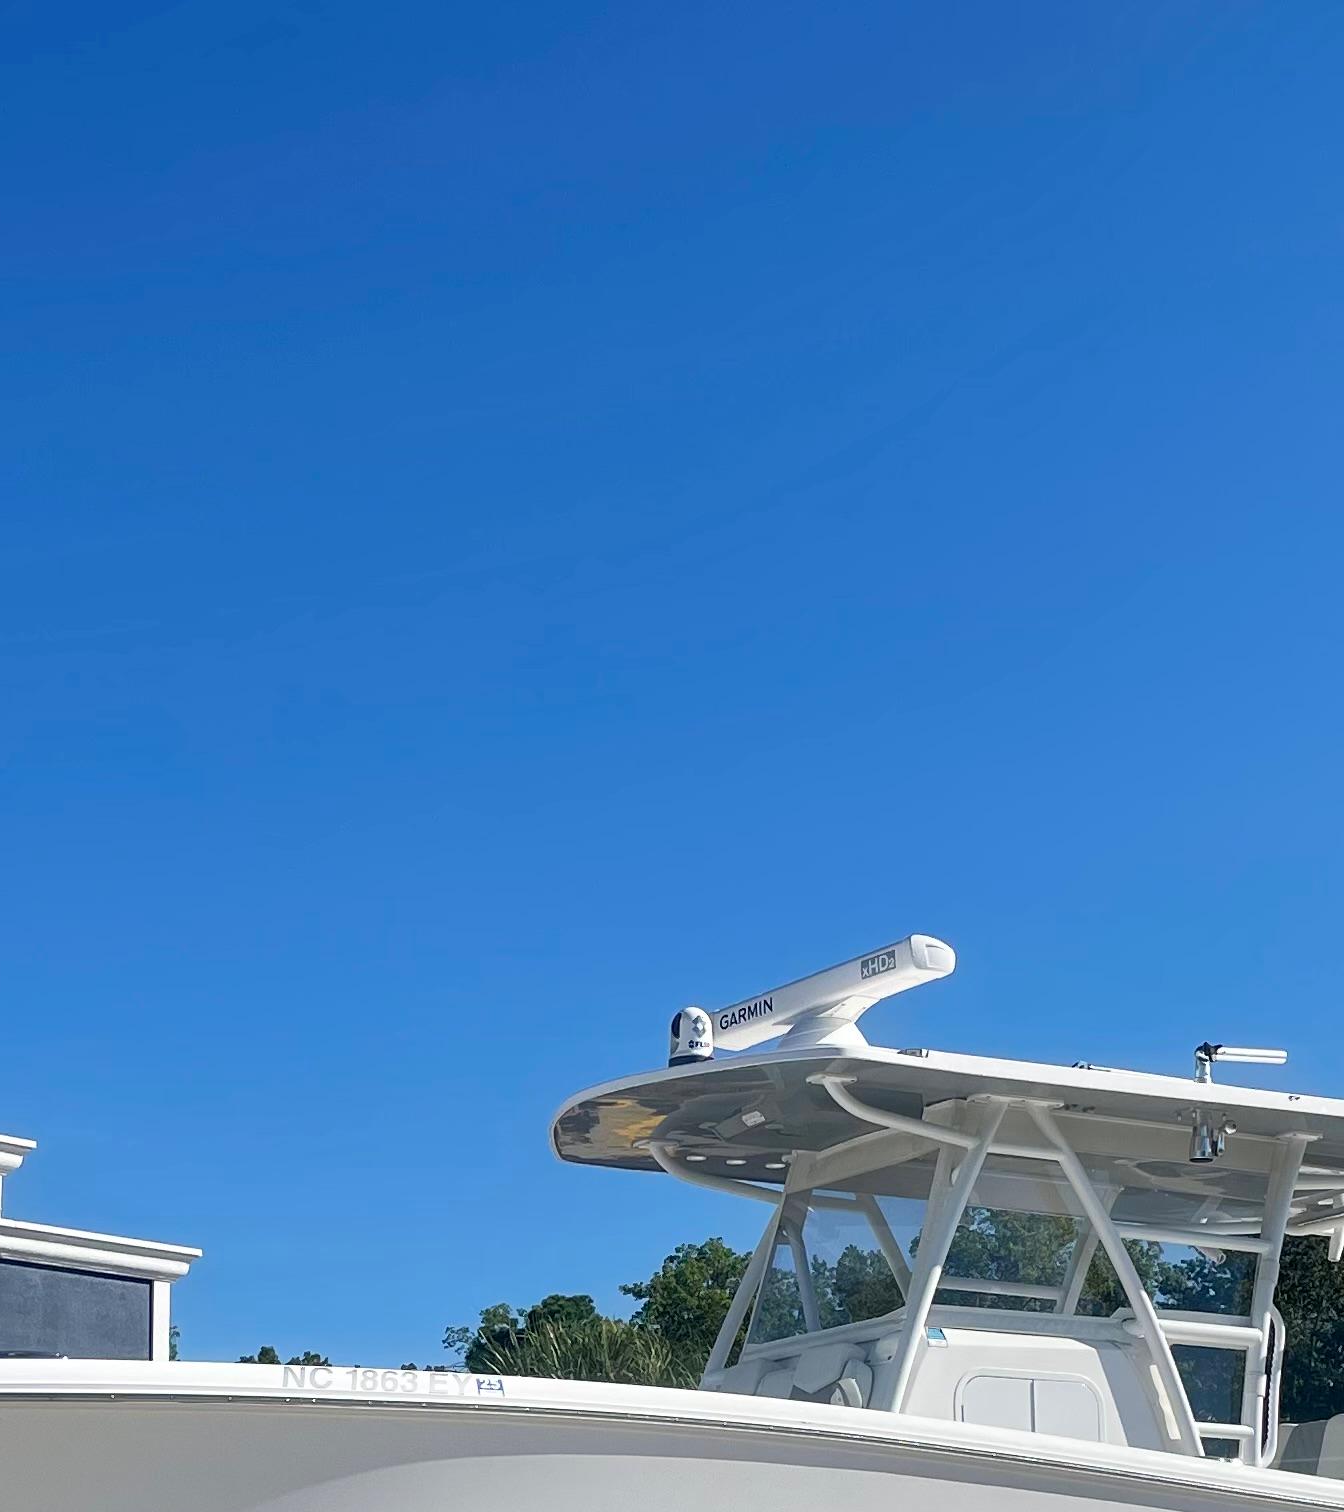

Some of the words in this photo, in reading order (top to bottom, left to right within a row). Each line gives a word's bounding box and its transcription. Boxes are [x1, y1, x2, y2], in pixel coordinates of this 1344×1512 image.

[719, 997, 773, 1030] GARMIN
[282, 1366, 333, 1389] NC
[346, 1369, 418, 1393] 1863
[428, 1373, 472, 1396] EY
